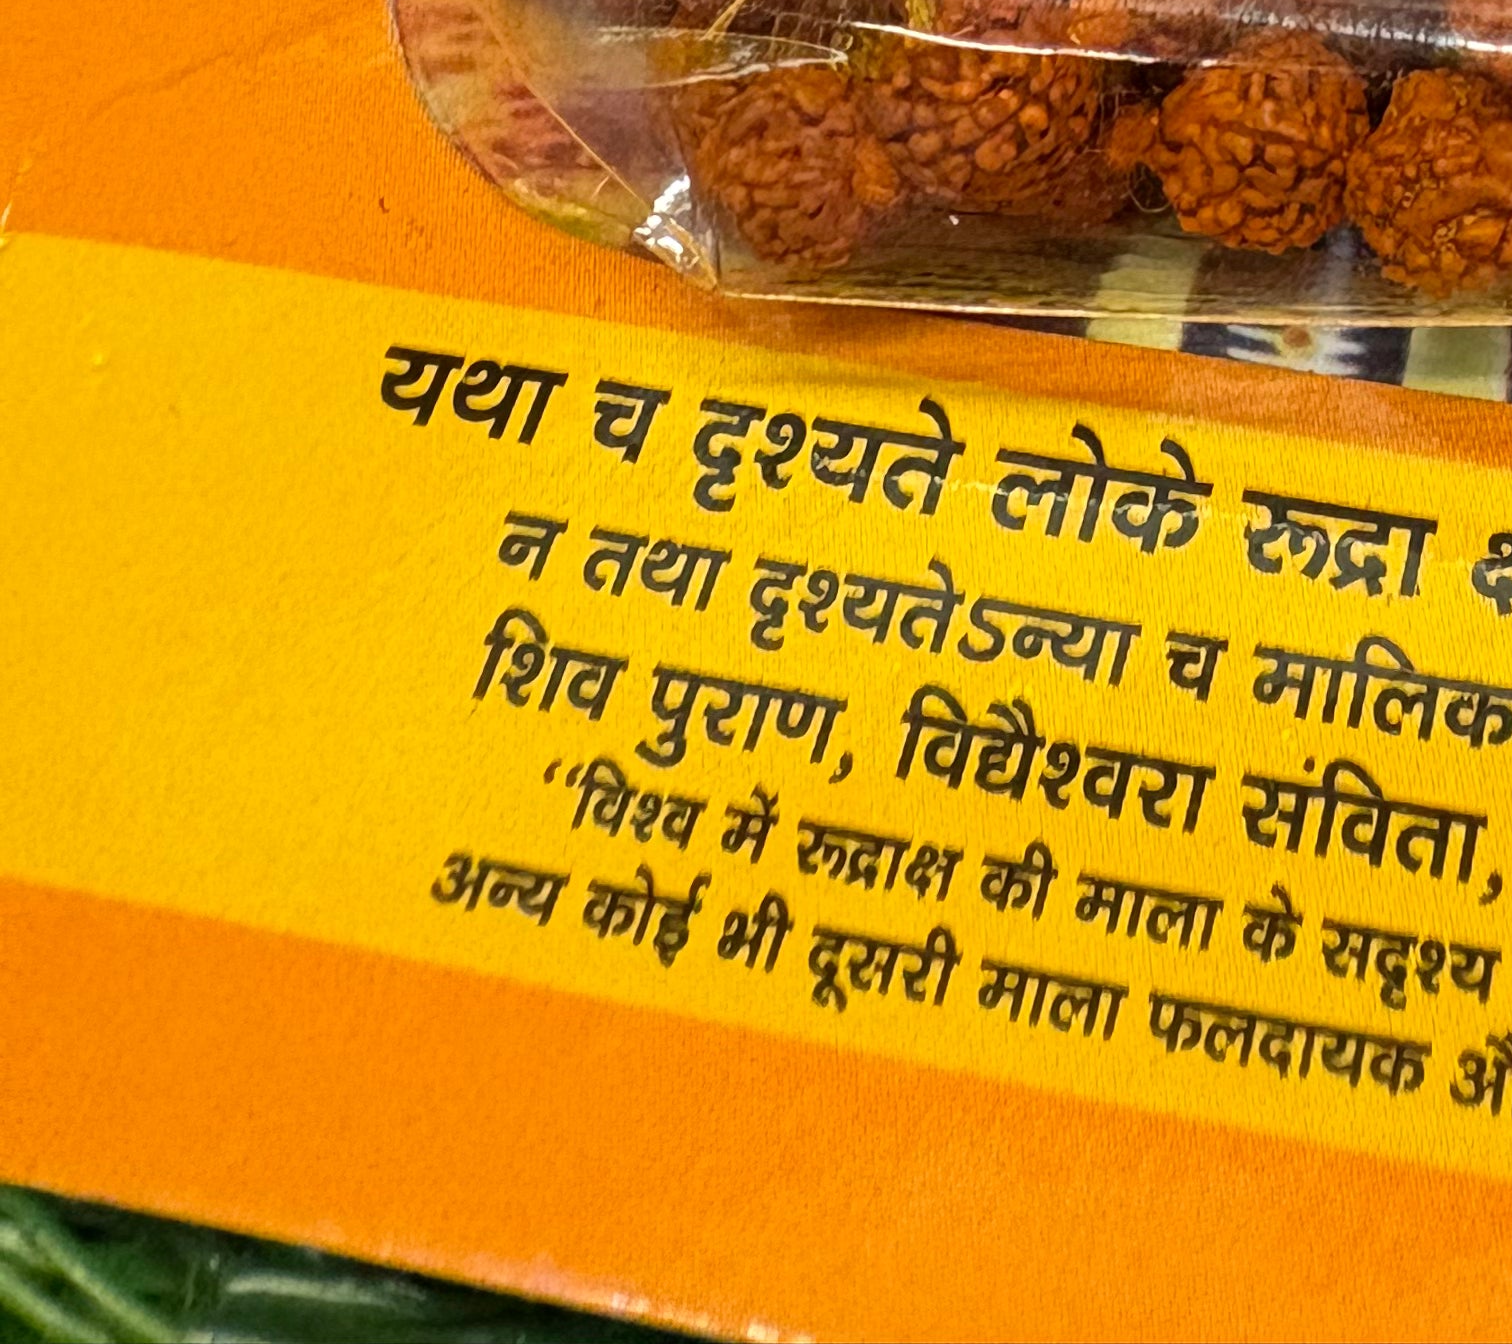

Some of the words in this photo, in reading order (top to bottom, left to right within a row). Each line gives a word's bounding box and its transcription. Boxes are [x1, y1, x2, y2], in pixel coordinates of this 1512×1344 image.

[378, 344, 571, 447] यथा
[592, 377, 674, 466] च
[691, 394, 968, 517] दृश्यते
[989, 420, 1216, 557] लोके
[496, 509, 571, 583] न
[581, 525, 735, 613] तथा
[1163, 628, 1231, 703] च
[471, 606, 631, 723] शिव
[633, 663, 855, 786] पुराण,
[1239, 743, 1505, 906] संविता,
[430, 853, 572, 928] अन्य
[581, 862, 713, 968] कोई
[715, 890, 796, 975] भी
[806, 923, 963, 1014] दूसरी
[976, 957, 1131, 1040] माला
[1146, 990, 1434, 1097] फलदायक
[719, 784, 781, 866] में
[978, 839, 1061, 921] की
[1073, 871, 1226, 952] माला
[1240, 882, 1306, 965] के
[1320, 916, 1504, 1012] सदृश्य
